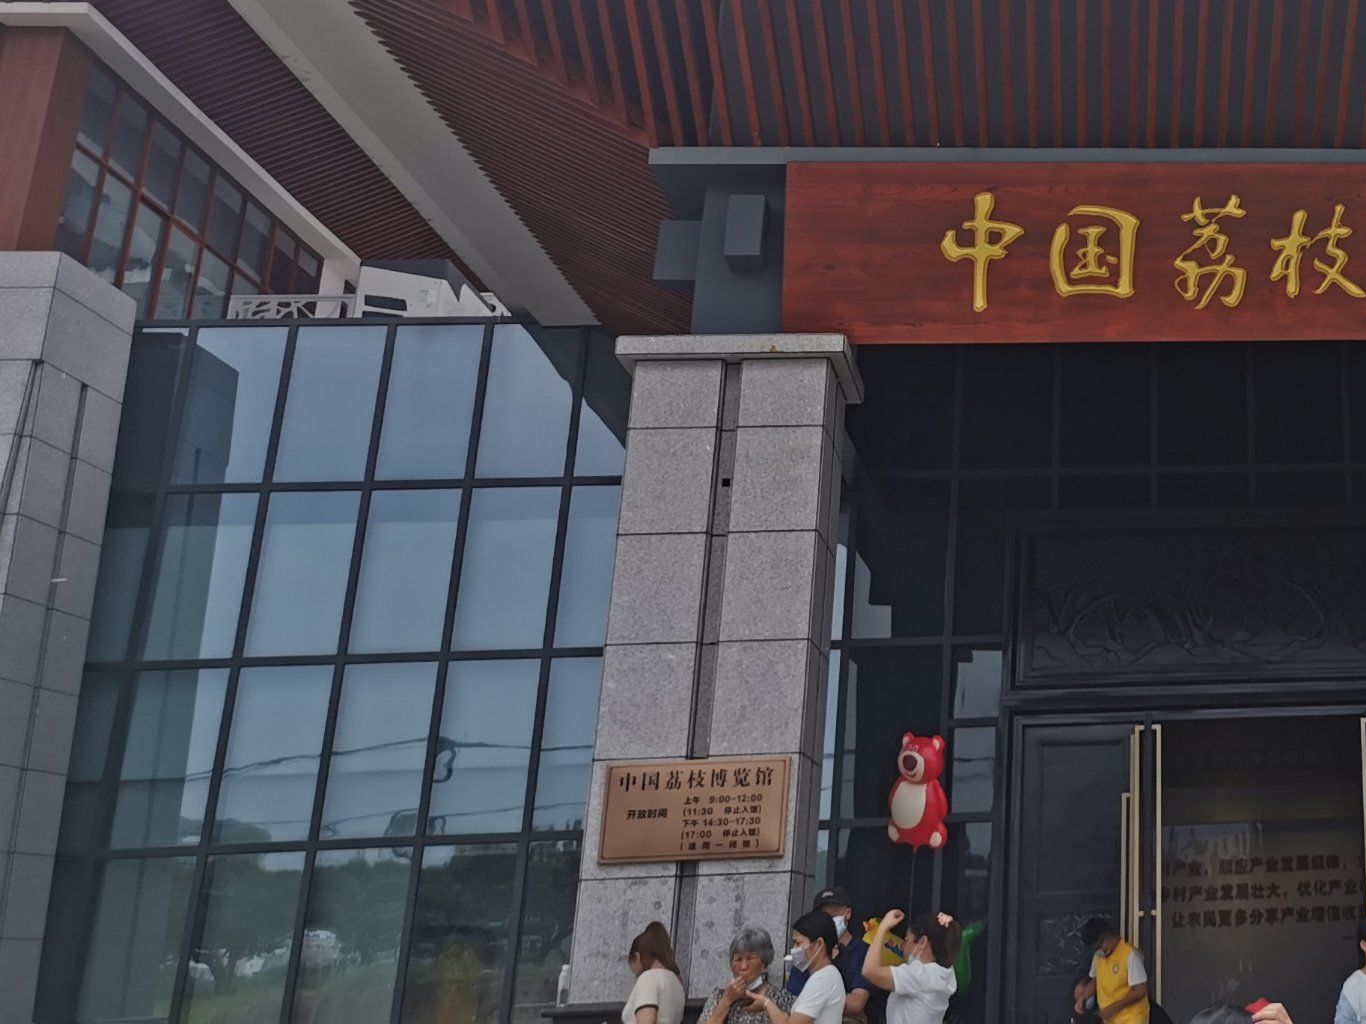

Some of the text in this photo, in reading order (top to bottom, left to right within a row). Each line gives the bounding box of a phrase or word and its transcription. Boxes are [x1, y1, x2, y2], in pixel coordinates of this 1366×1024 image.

[619, 767, 774, 792] 中国荔枝博览馆
[684, 796, 700, 805] 上午
[626, 808, 668, 820] 开放时间
[683, 819, 698, 828] 下午
